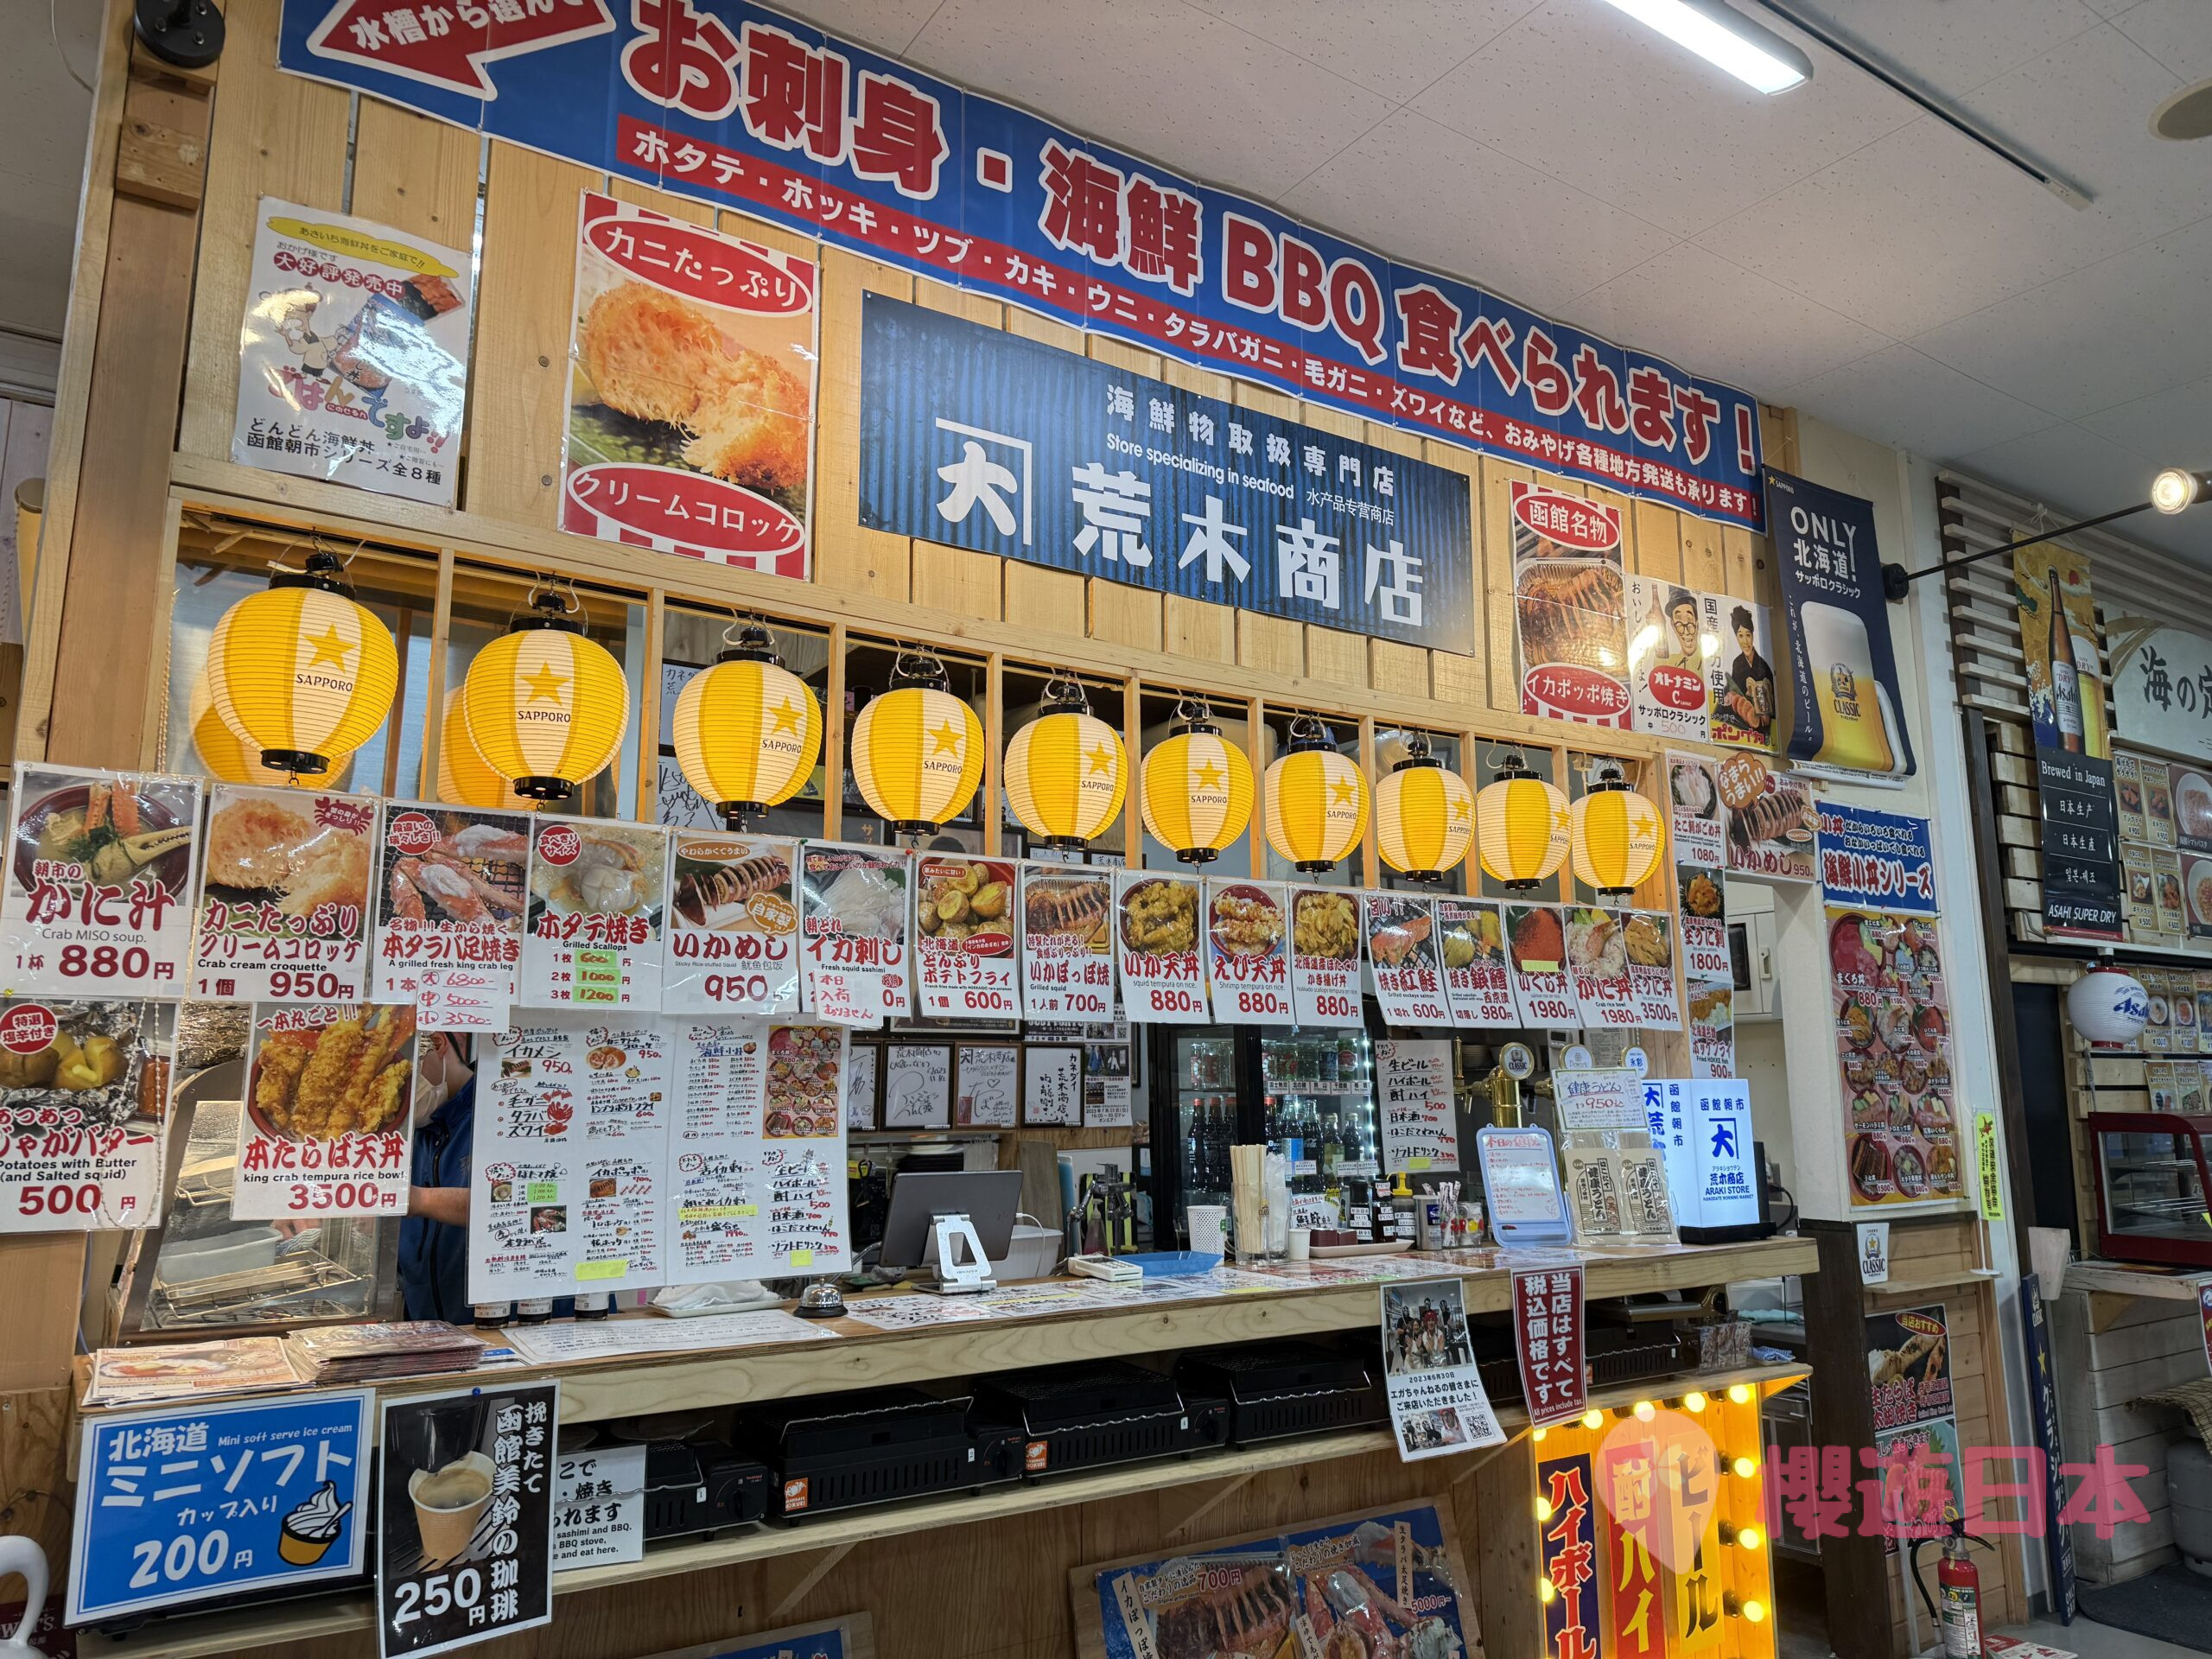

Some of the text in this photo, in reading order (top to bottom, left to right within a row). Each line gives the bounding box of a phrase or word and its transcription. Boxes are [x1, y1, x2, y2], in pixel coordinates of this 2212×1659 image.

[274, 251, 404, 297] 大好評発売中
[605, 226, 797, 308] カニたっぷり
[1223, 213, 1386, 365] BBQ
[251, 417, 375, 454] どんどん海鮮丼
[1108, 384, 1395, 496] 海鮮物取扱専門店
[1107, 432, 1294, 499] Store specializing seafood
[1775, 480, 1795, 493] SAPPORO
[576, 473, 802, 543] クリームコロッケ
[1306, 487, 1395, 526] 水产品专营商店
[1529, 499, 1608, 543] 函館名物
[1071, 462, 1422, 627] 荒木商店
[1796, 569, 1860, 599] サッポロクラシック
[296, 674, 353, 693] SAPPORO
[1527, 674, 1629, 709] イカポッポ焼き
[518, 710, 571, 724] SAPPORO
[1638, 704, 1706, 725] サッポロクラシック
[1834, 699, 1861, 718] CLASSIC
[762, 740, 802, 753] SAPPORO
[924, 760, 963, 774] SAPPORO
[2042, 760, 2071, 779] Brewed
[2085, 770, 2106, 788] Japan
[1081, 779, 1115, 793] SAPPORO
[1191, 795, 1228, 804] SAPPORO
[1326, 810, 1357, 820] SAPPORO
[546, 844, 577, 856] サイズ
[681, 847, 748, 856] やわらかくてうまい
[1692, 848, 1719, 863] 1080円
[1729, 845, 1792, 875] いかめし
[35, 861, 81, 879] 朝市の
[1823, 849, 1933, 899] 海鮮小丼シリーズ
[26, 880, 175, 931] かに汁
[2049, 905, 2117, 924] ASAHI SUPER DRY
[203, 899, 359, 937] カニたっぷり
[537, 911, 649, 944] ホタテ焼き
[42, 928, 147, 946] Crab MISO soup.
[200, 932, 362, 963] クリームコロッケ
[563, 940, 627, 951] Grilled Scallops
[673, 933, 788, 961] いかめし
[922, 937, 960, 951] 北海道
[382, 935, 520, 963] 本タラバ足焼き
[807, 936, 902, 965] イカ刺し
[59, 944, 175, 980] 880円
[198, 959, 226, 969] Crab
[270, 963, 327, 972] croquette
[398, 960, 429, 970] grilled
[455, 962, 475, 971] king
[477, 962, 498, 970] crab
[924, 952, 980, 969] どんぶり
[1123, 951, 1199, 981] いか天丼
[1215, 954, 1286, 983] えび天丼
[1690, 953, 1729, 972] 1800円
[924, 968, 1010, 986] ポテトフライ
[1030, 960, 1109, 986] いかぽっぽ焼
[1518, 972, 1568, 994] いくら丼
[198, 972, 354, 999] 1個 950円
[1577, 976, 1633, 1001] かに丼
[964, 991, 1013, 1010] 600円
[1065, 994, 1106, 1012] 700円
[1150, 989, 1203, 1012] 880円
[1238, 992, 1288, 1014] 880円
[1316, 995, 1358, 1017] 880円
[1413, 1003, 1446, 1019] 600円
[1529, 1001, 1576, 1019] 1980円
[15, 1014, 42, 1027] 特選
[1481, 1005, 1513, 1020] 980円
[1601, 1009, 1643, 1023] 1980円
[1641, 1002, 1678, 1022] 3500円
[505, 1046, 561, 1058] イカメシ
[1509, 1062, 1528, 1071] CLASSIC
[1669, 1084, 1683, 1147] 函館朝市
[1700, 1098, 1745, 1111] 函館朝市
[243, 1132, 404, 1171] 本たらば天丼
[61, 1159, 90, 1168] with
[96, 1158, 137, 1168] Butter
[0, 1171, 31, 1182] (and
[36, 1170, 79, 1181] Salted
[244, 1171, 374, 1183] king crab tempura rice
[1710, 1172, 1745, 1185] 荒木商店
[288, 1182, 397, 1211] 3500円
[1706, 1186, 1726, 1195] ARAKI
[1862, 1257, 1885, 1274] CLASSIC
[1551, 1273, 1574, 1397] 当店はすべて
[1902, 1314, 1939, 1334] 当店おすすめ
[1525, 1275, 1553, 1404] 税込価格です
[1541, 1401, 1573, 1414] prices include
[109, 1423, 209, 1461] 北海道
[218, 1425, 352, 1446] Mini soft serve cream
[523, 1402, 547, 1493] 挽きたて
[101, 1440, 353, 1508] ミニソフト
[178, 1494, 278, 1526] カップ入り
[491, 1403, 524, 1622] 函館美鈴の珈琲
[557, 1526, 607, 1539] sashimi and
[1676, 1446, 1718, 1639] ビール
[129, 1529, 252, 1589] 200円
[562, 1549, 577, 1559] and
[1548, 1466, 1596, 1659] ハイボール
[393, 1571, 486, 1625] 250円
